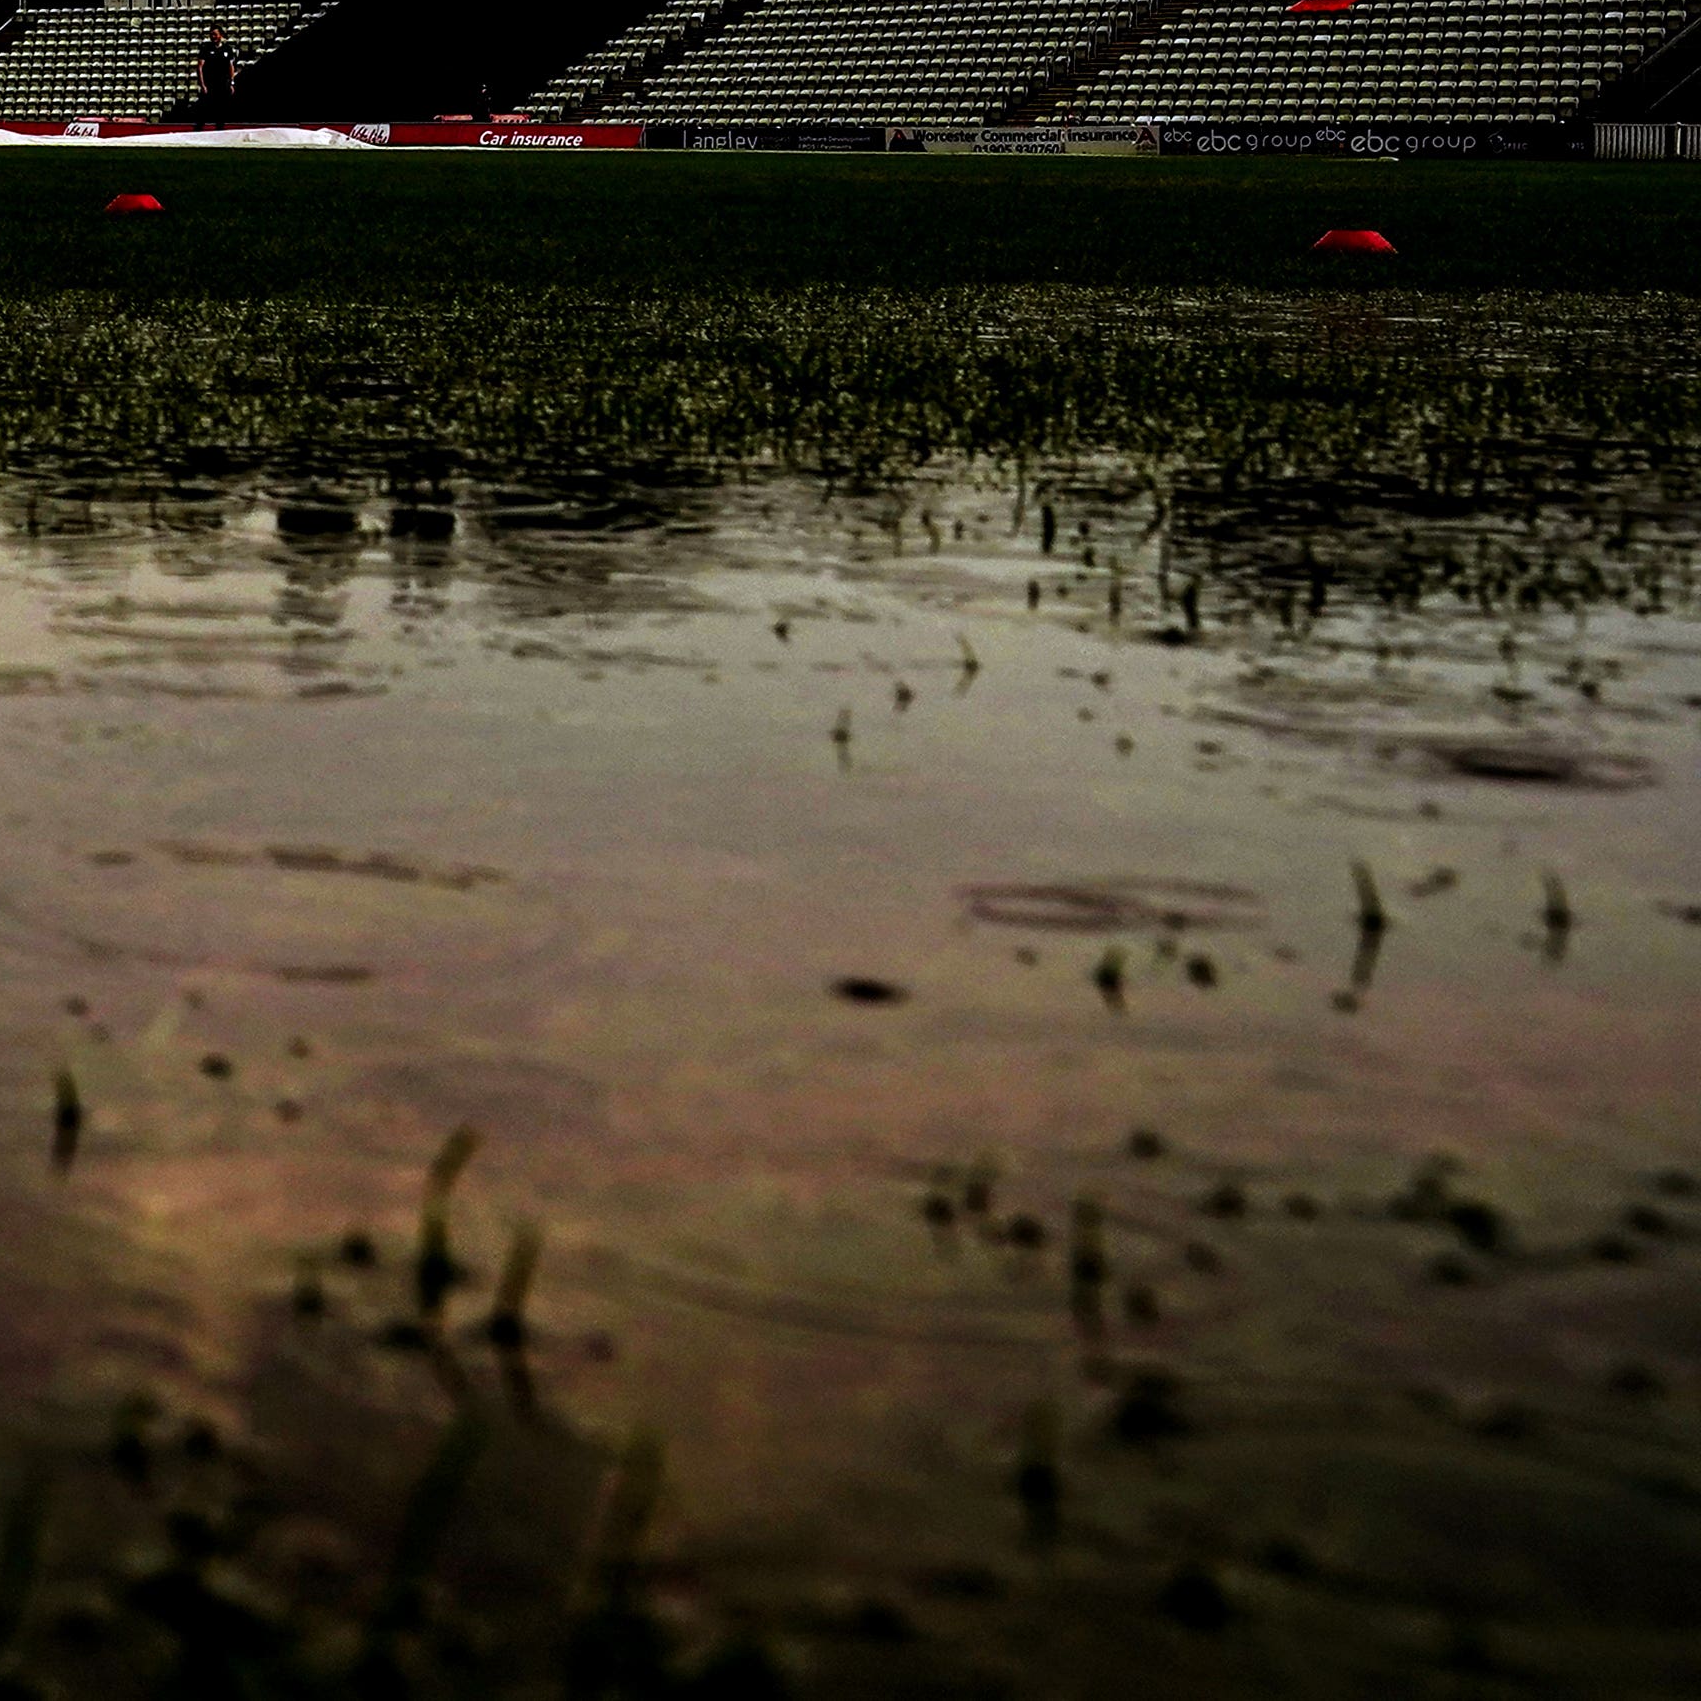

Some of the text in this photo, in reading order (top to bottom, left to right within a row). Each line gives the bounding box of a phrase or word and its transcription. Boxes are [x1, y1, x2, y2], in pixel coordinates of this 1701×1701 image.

[479, 131, 583, 146] Car insurance
[912, 130, 979, 142] Worcester
[981, 129, 1061, 142] Commercial
[1163, 127, 1193, 143] ebc
[1196, 129, 1312, 153] ebc group
[1315, 126, 1347, 142] ebc
[1350, 129, 1476, 153] ebc group
